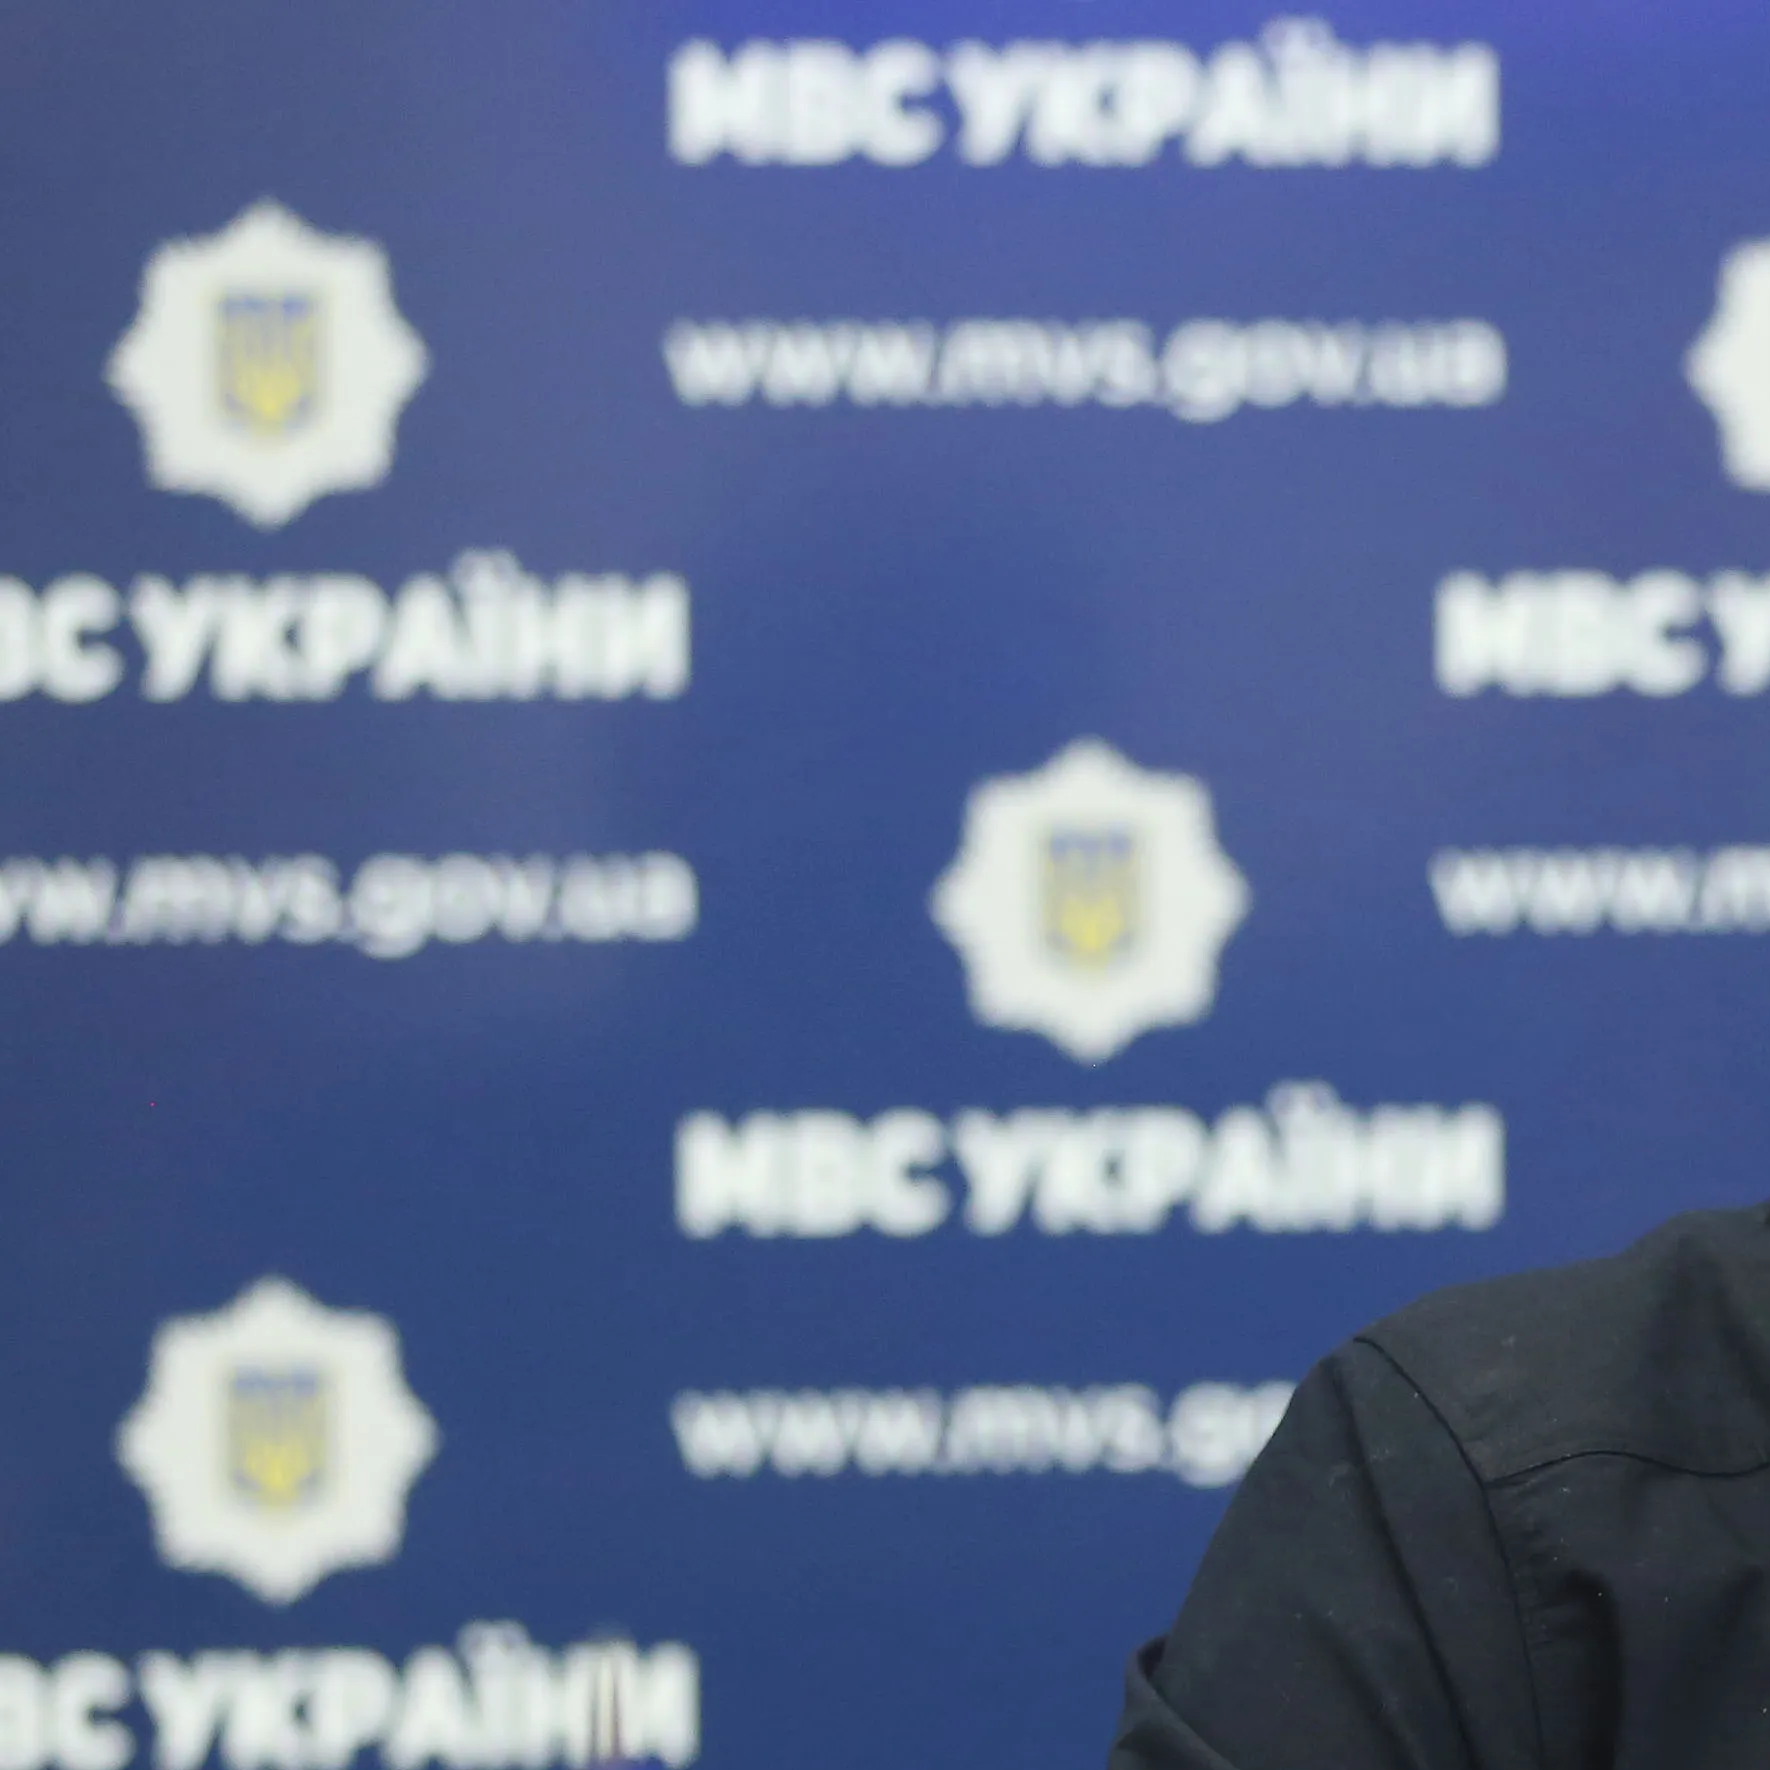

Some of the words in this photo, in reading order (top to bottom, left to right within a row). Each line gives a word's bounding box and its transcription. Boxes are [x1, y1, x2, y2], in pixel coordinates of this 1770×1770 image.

[668, 40, 944, 166] МВС
[944, 19, 1499, 166] УКРАЇНИ
[664, 320, 1507, 422] www.mvs.gov.ua
[125, 550, 690, 700] УКРАЇНИ
[1435, 571, 1707, 695] МВС
[675, 1110, 951, 1237] МВС
[951, 1083, 1504, 1233] УКРАЇНИ
